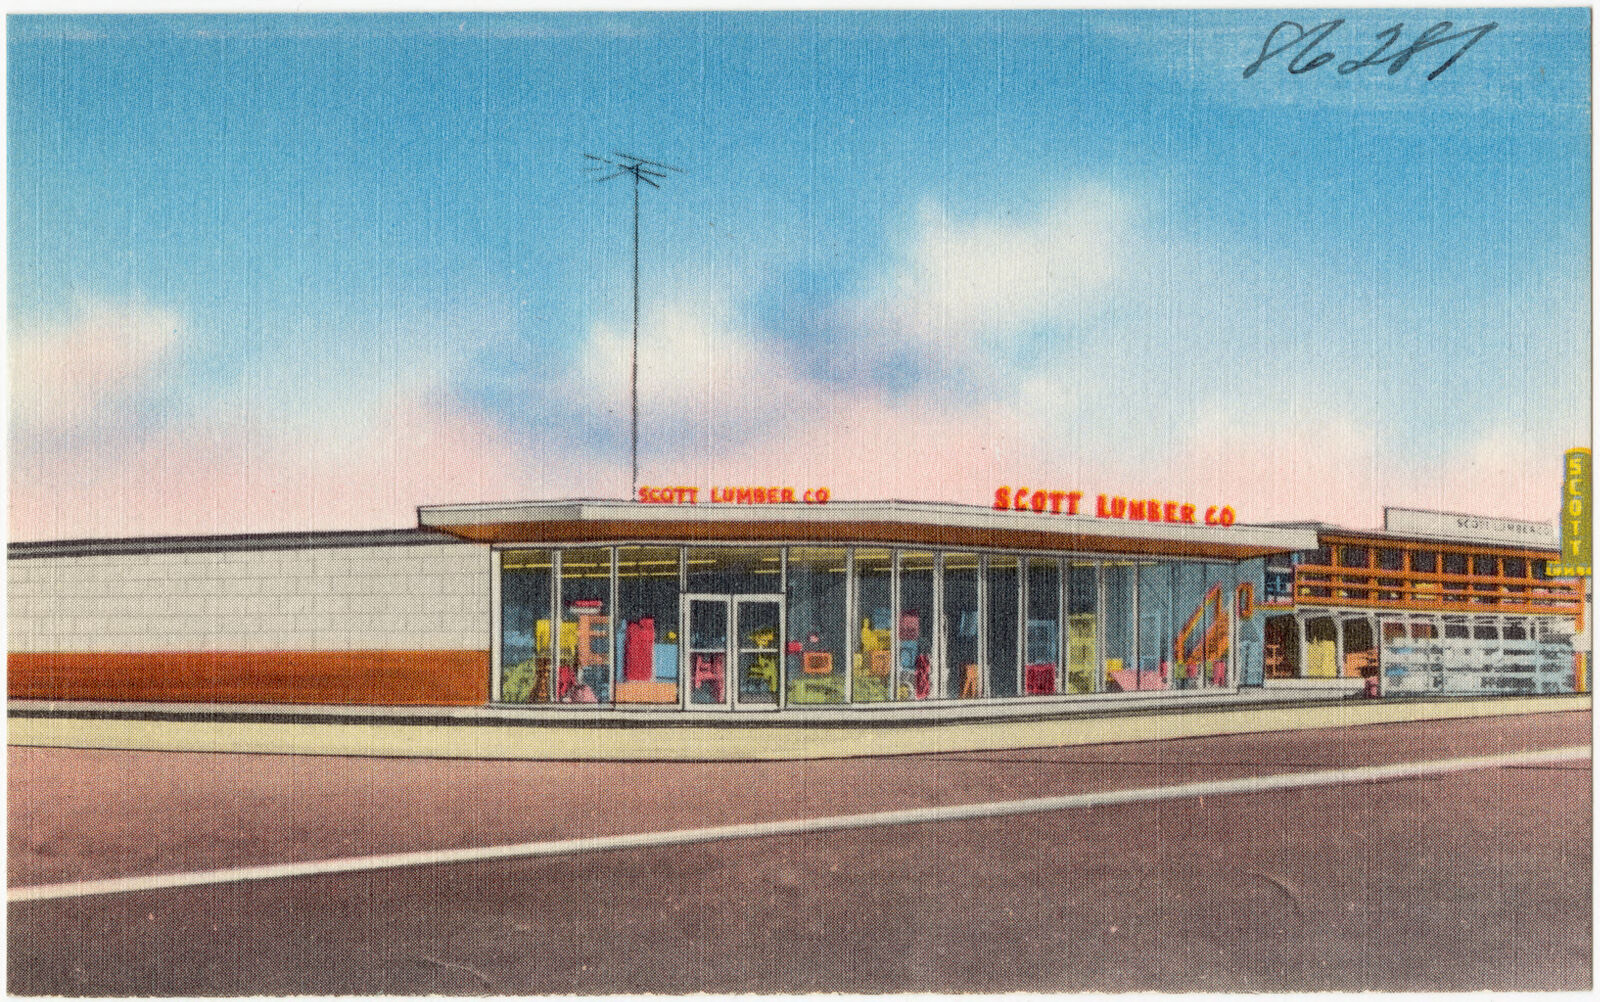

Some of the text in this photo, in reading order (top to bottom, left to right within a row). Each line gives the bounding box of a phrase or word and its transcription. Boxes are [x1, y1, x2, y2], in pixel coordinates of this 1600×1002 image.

[638, 486, 830, 505] SCOTT LUMBER CO
[993, 485, 1236, 527] SCOTT LUMBER CO
